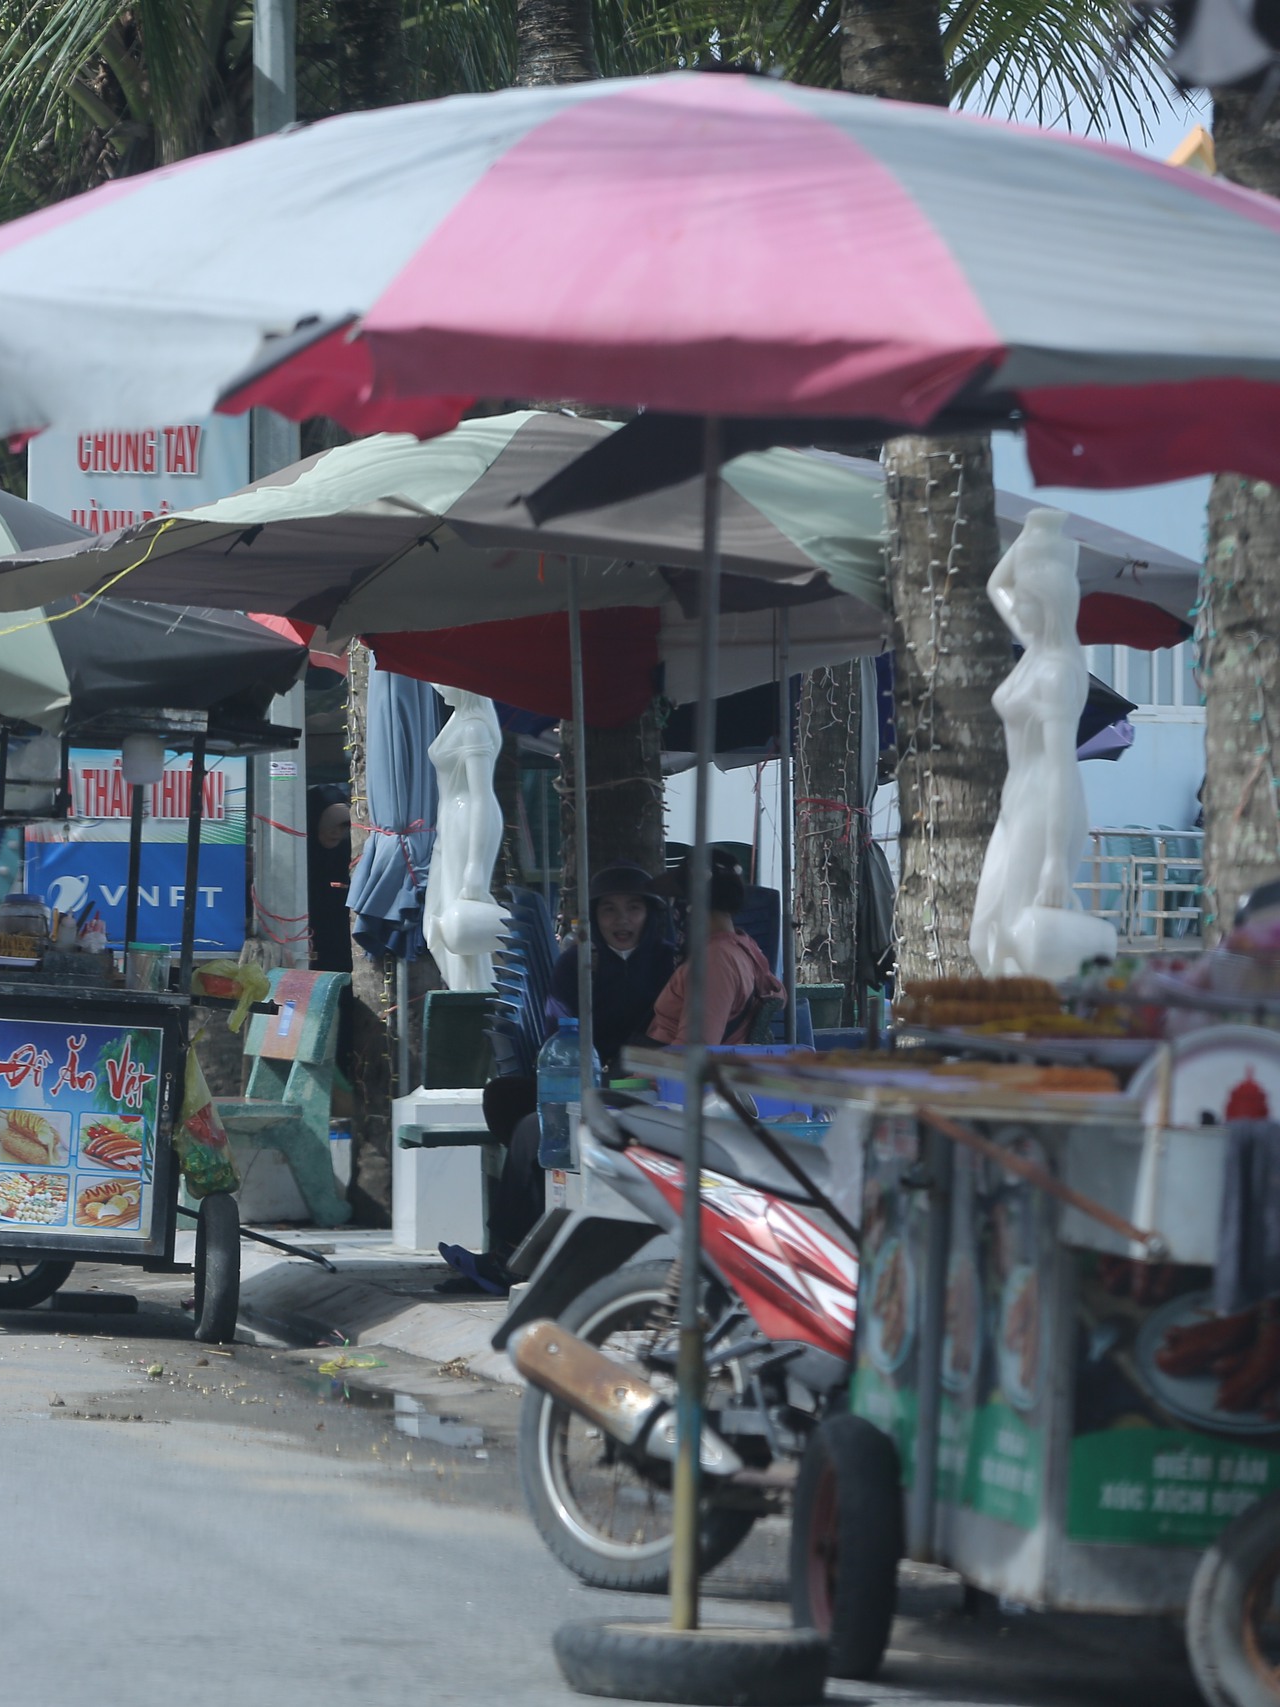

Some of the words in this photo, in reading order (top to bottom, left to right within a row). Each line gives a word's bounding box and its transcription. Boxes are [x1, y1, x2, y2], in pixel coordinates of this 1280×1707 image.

[77, 430, 158, 473] CHUNG
[162, 425, 202, 475] TAY
[50, 1034, 96, 1096] Ăn
[106, 1034, 156, 1108] Vặt
